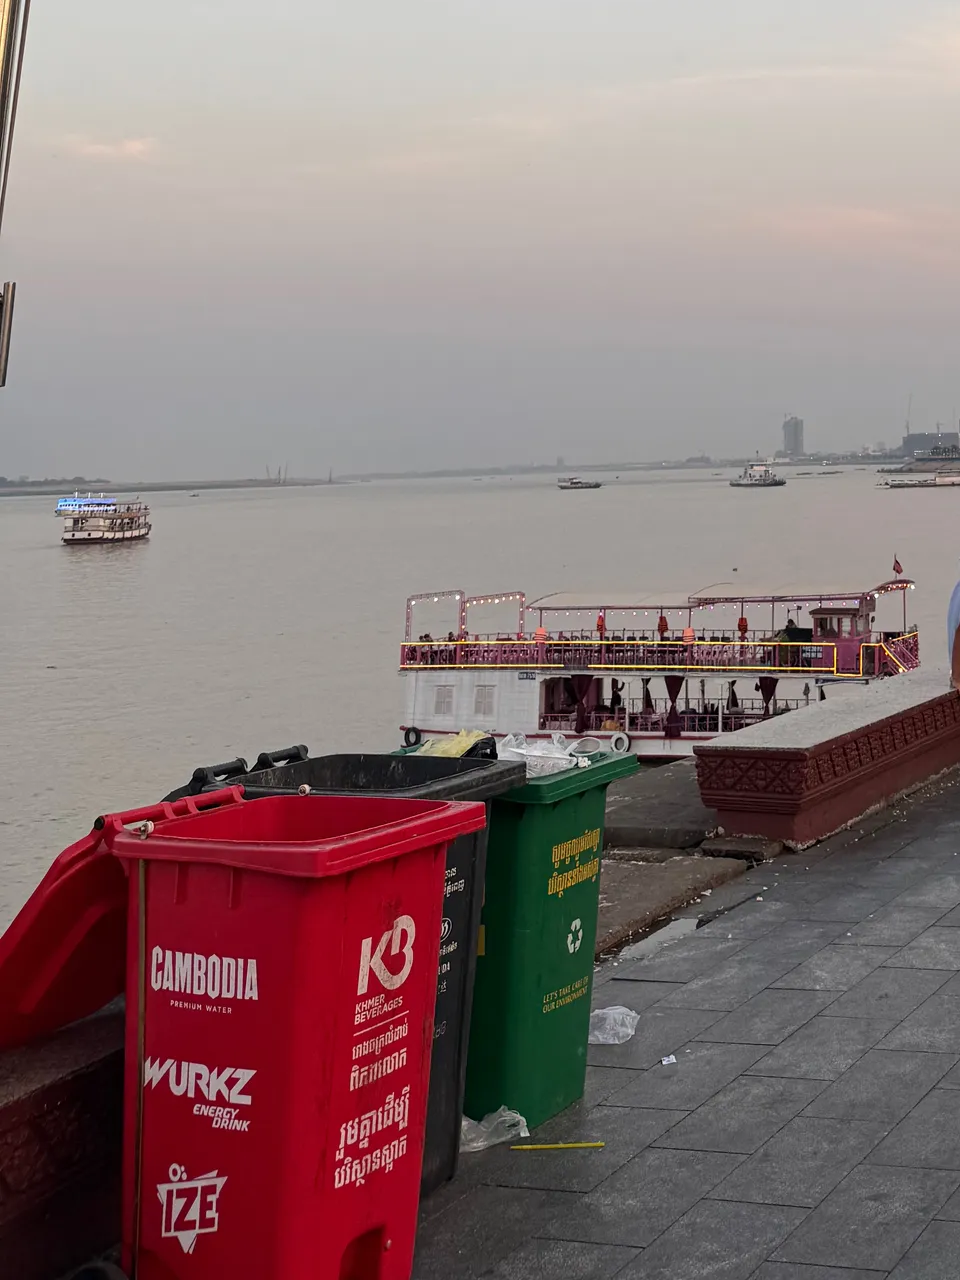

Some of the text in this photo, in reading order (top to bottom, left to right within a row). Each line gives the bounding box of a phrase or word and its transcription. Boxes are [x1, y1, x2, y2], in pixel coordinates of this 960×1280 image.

[150, 945, 259, 1000] CAMBODIA
[170, 1000, 232, 1014] PREMIUM WATER
[354, 996, 403, 1025] BEVERAGES
[355, 993, 385, 1014] KHMER
[143, 1055, 257, 1106] WURKZ
[192, 1103, 239, 1119] ENERGY
[211, 1117, 251, 1132] DRINK
